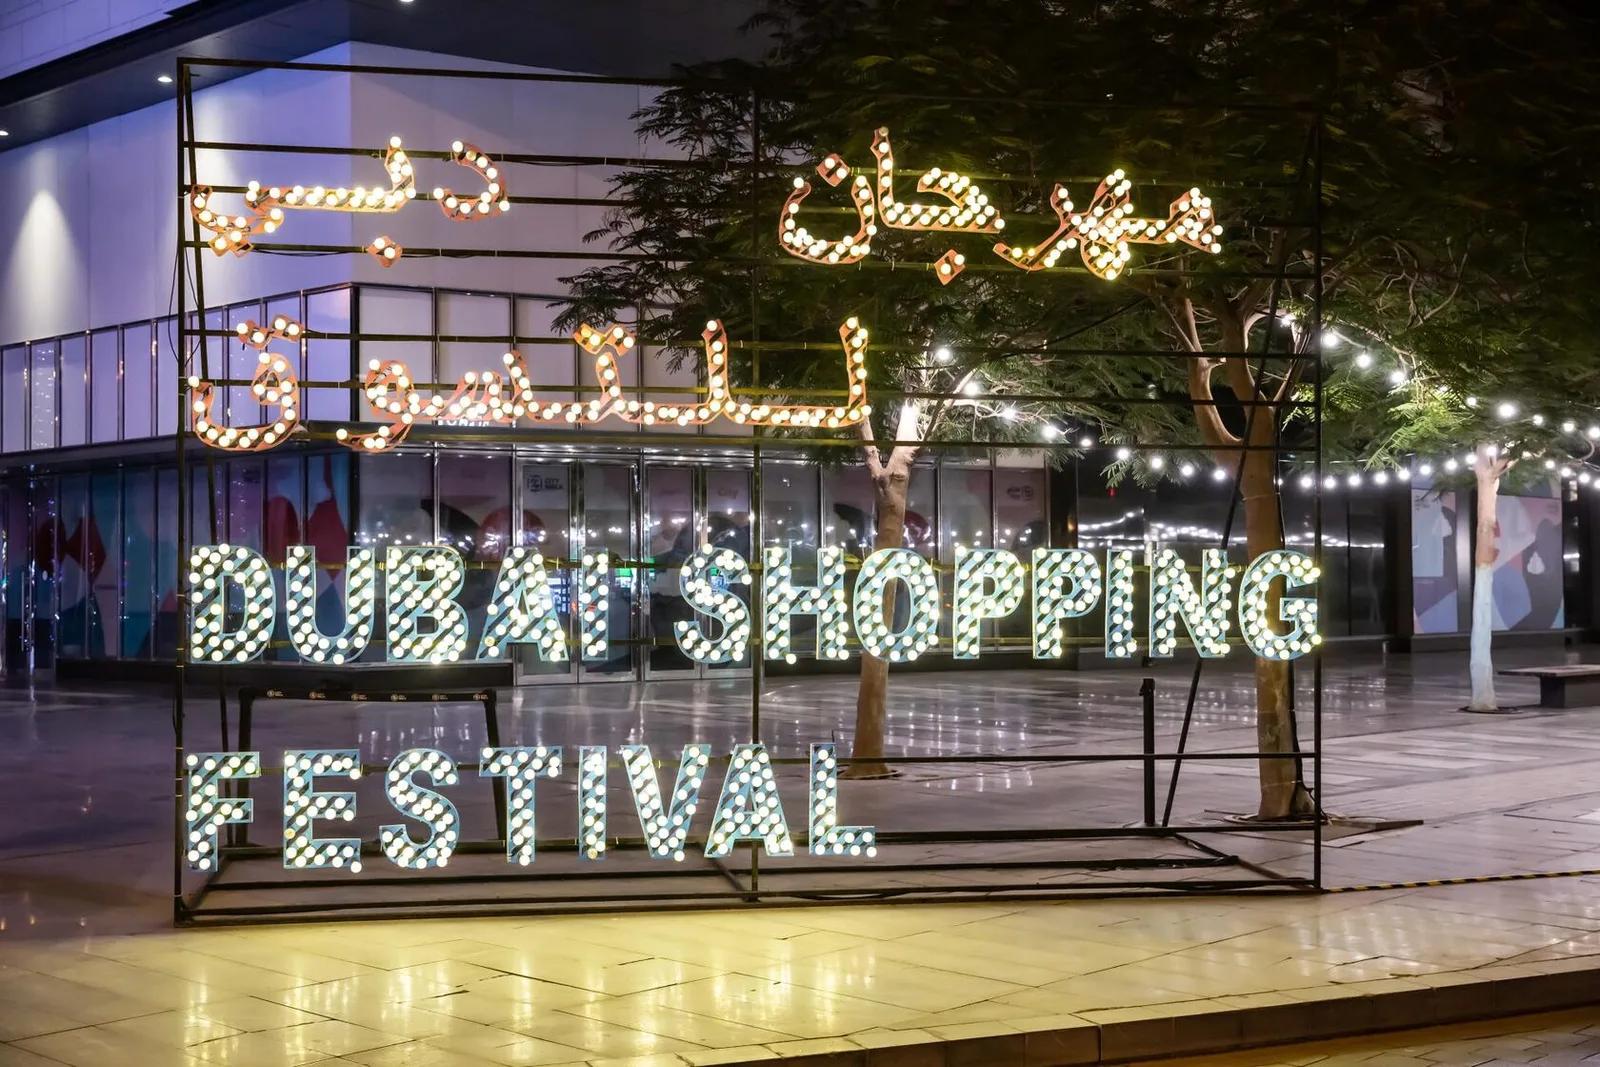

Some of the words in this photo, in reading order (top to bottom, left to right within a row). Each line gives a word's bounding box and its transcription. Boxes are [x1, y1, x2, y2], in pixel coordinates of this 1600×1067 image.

[190, 136, 511, 267] دبي
[778, 126, 1224, 284] مهرجان
[190, 317, 871, 452] للتسوق
[190, 545, 611, 664] DUBAI
[673, 543, 1322, 664] SHOPPING
[184, 743, 877, 873] FESTIVAL
